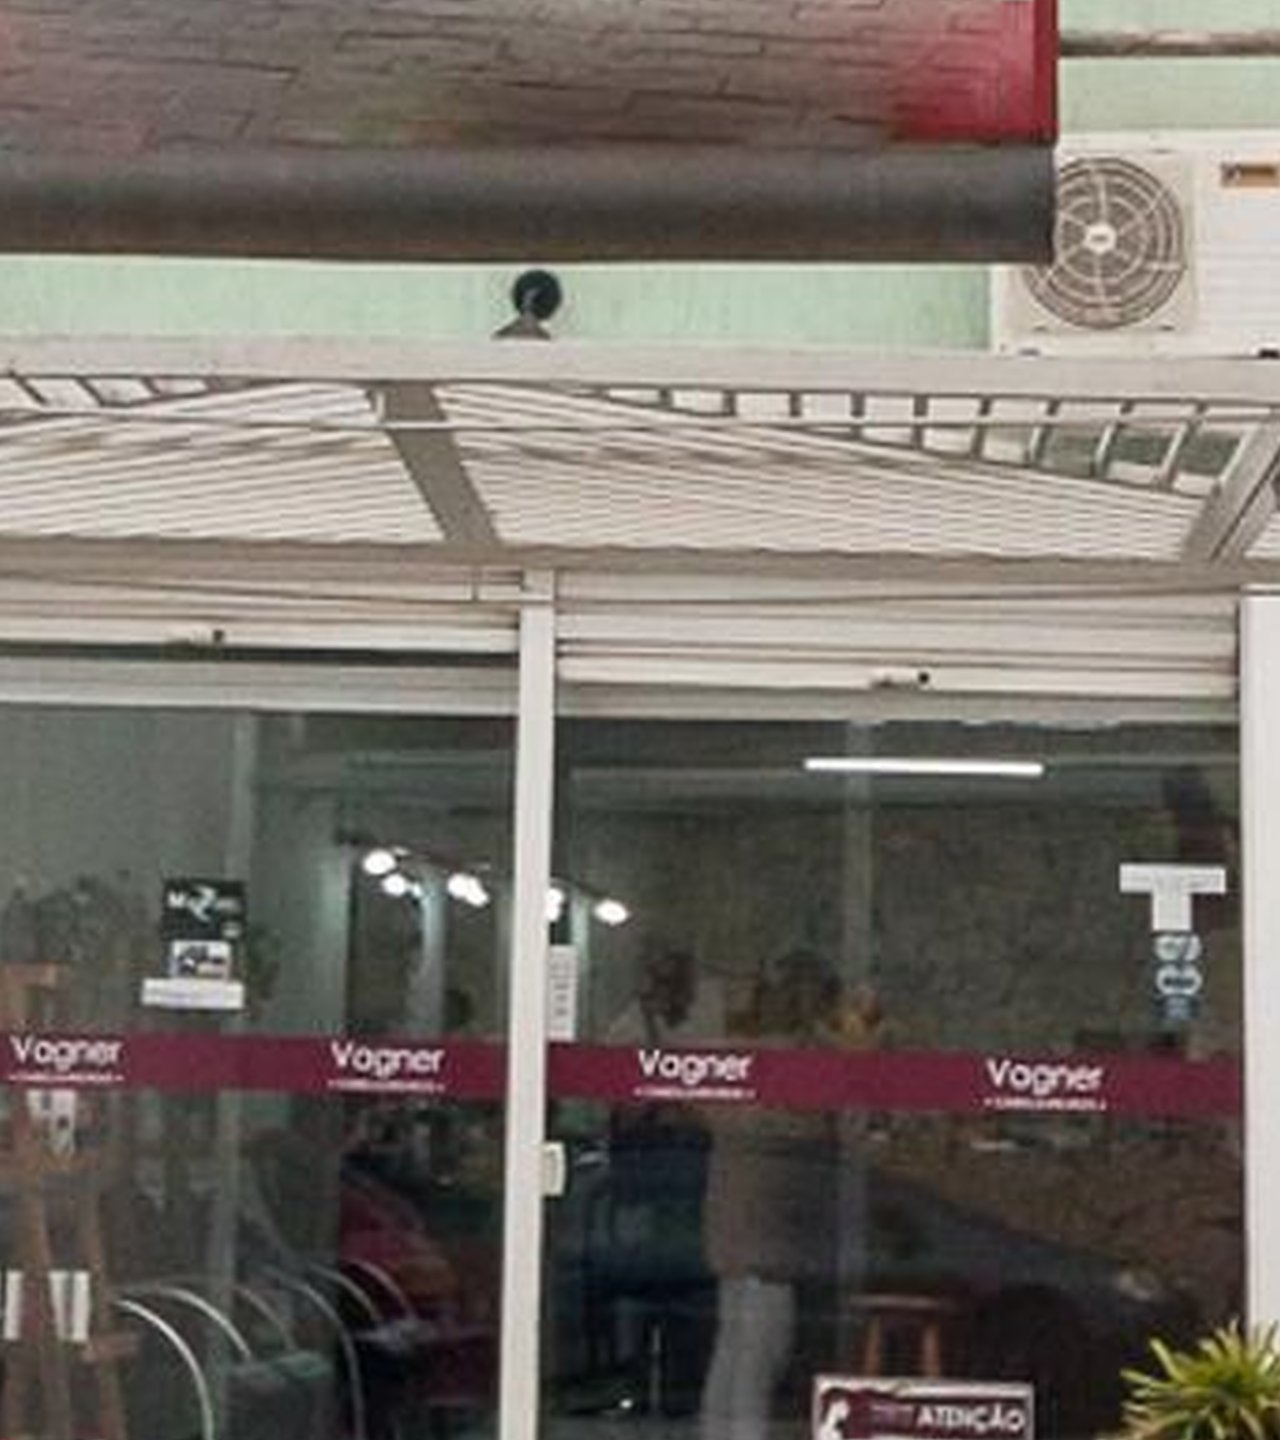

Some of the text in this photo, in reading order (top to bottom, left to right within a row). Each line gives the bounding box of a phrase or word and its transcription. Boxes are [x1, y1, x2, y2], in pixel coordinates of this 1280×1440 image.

[10, 1035, 123, 1072] Vagner
[331, 1041, 444, 1077] Vagner
[639, 1049, 754, 1085] Vagner
[987, 1059, 1102, 1094] Vagner
[917, 1403, 1025, 1433] ATENÇÃO
